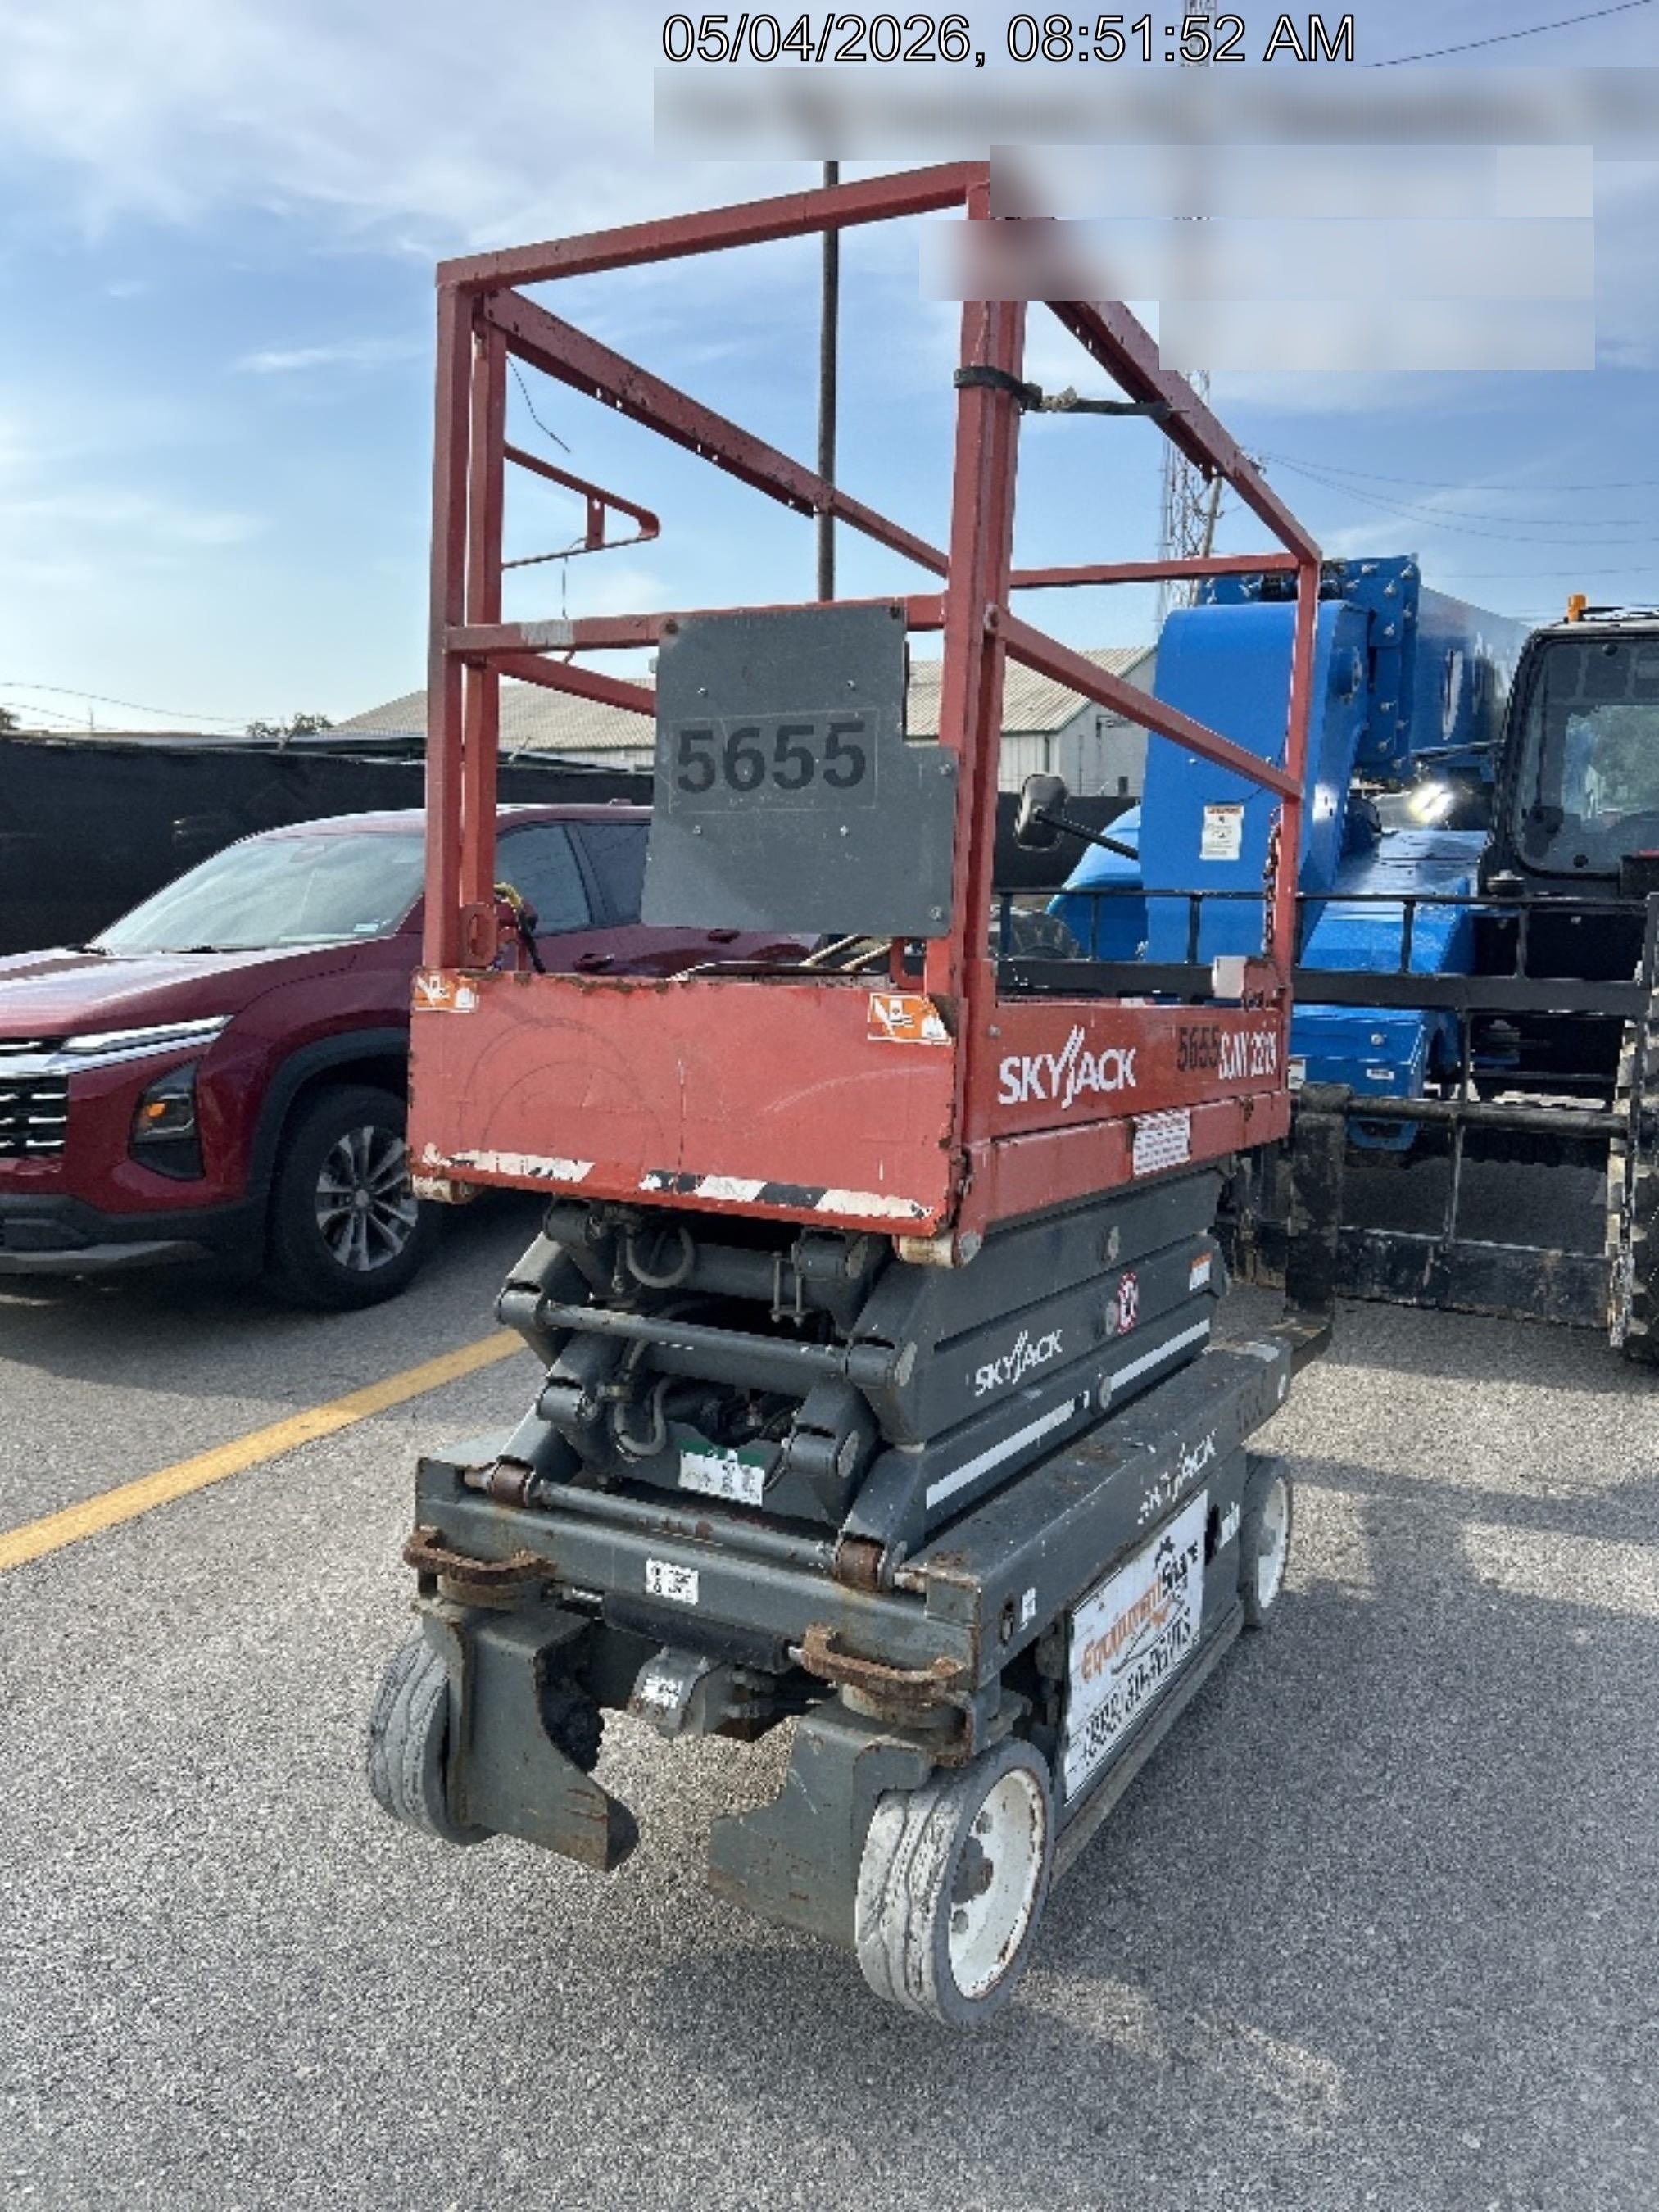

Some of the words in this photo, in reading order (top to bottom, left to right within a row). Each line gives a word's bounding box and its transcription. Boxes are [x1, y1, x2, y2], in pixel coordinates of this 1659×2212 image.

[677, 721, 866, 793] 5655
[997, 1024, 1136, 1109] SKYJACK
[1177, 1026, 1221, 1072] 5655
[975, 1330, 1063, 1396] SKYJACK
